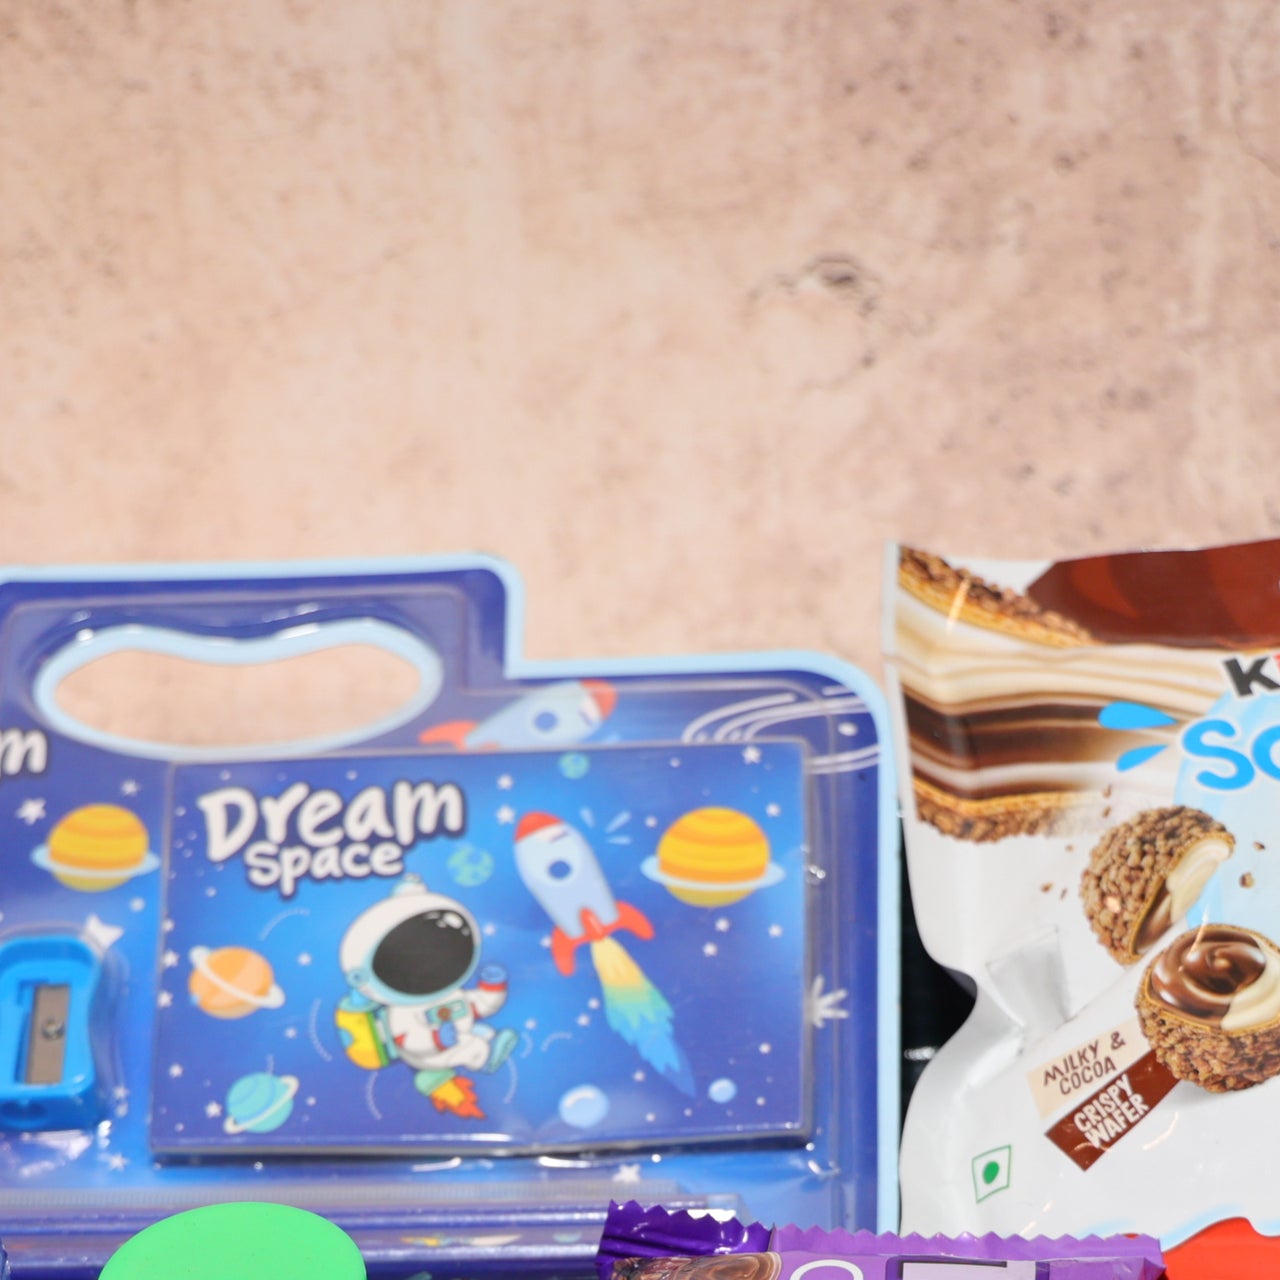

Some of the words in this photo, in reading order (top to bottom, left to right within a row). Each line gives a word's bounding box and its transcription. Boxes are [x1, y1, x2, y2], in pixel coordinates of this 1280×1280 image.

[197, 779, 464, 863] Dream
[1043, 1040, 1099, 1087] MILKY
[1110, 1031, 1126, 1051] &
[1059, 1056, 1117, 1095] COCOA
[1074, 1073, 1134, 1132] CRISPY
[1084, 1093, 1150, 1149] WAFER
